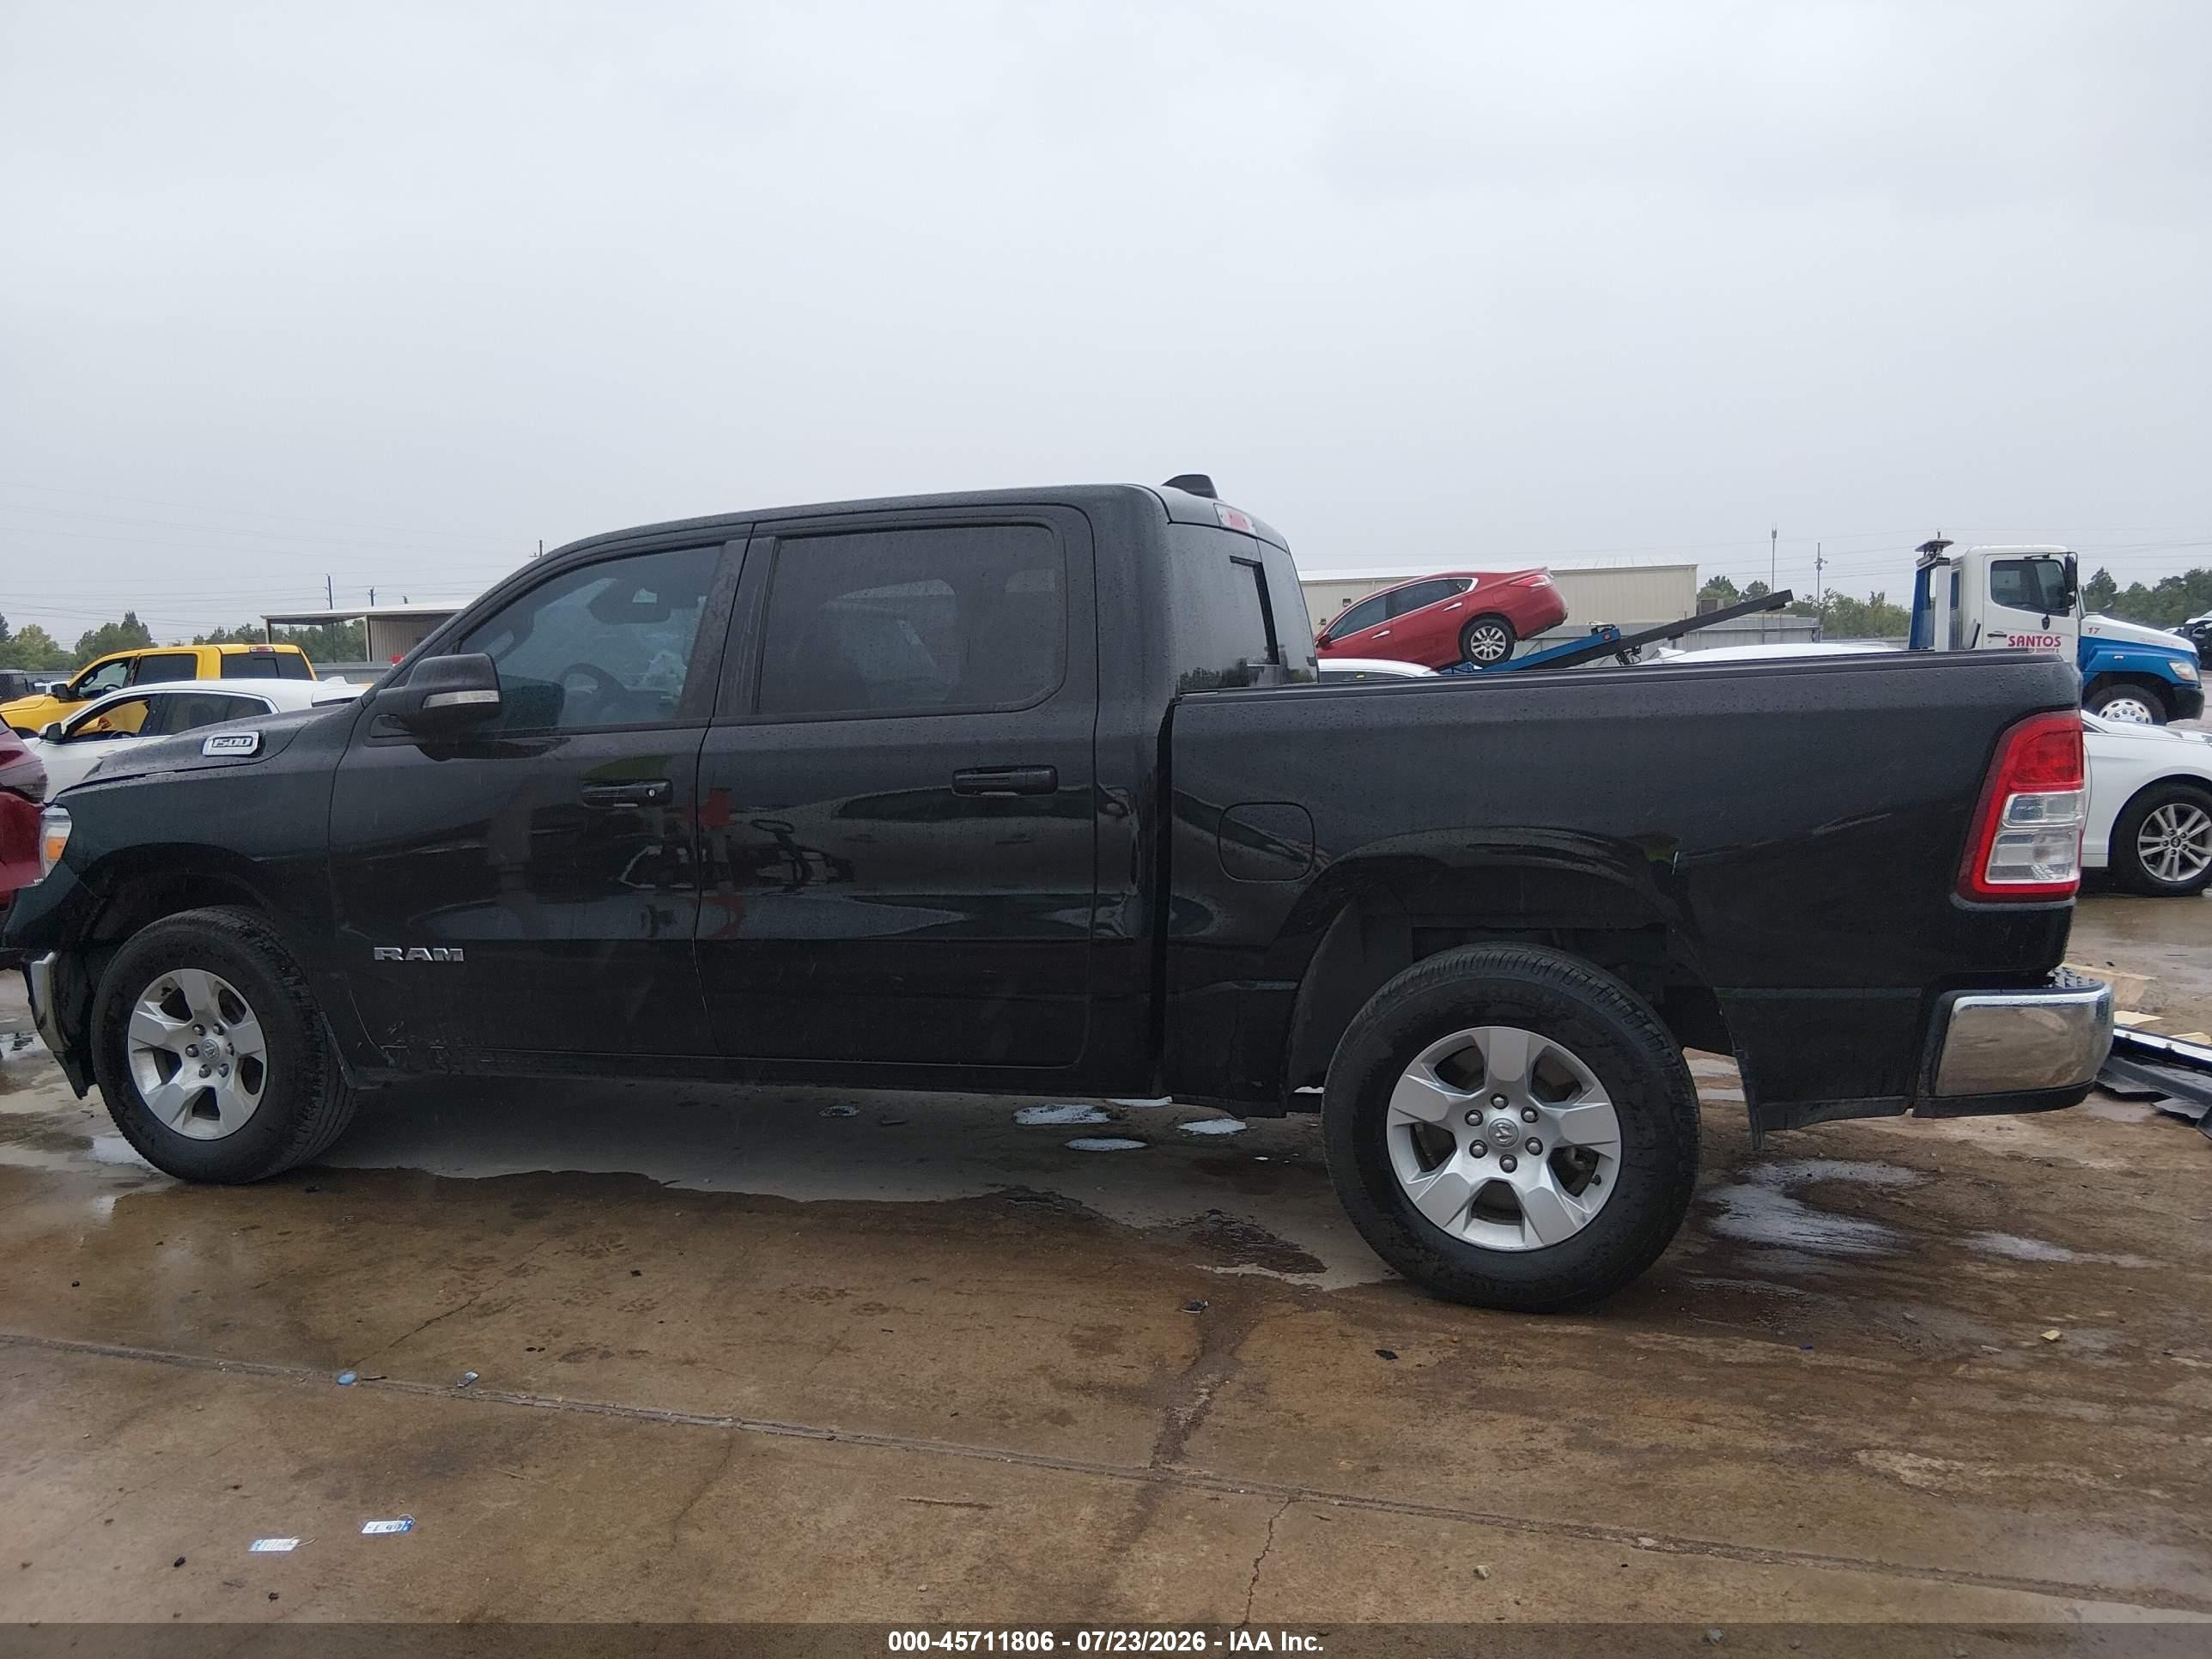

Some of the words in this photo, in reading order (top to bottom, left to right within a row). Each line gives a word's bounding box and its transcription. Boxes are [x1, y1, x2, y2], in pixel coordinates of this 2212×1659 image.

[2008, 635, 2062, 647] SANTOS
[212, 738, 252, 748] 1500
[374, 947, 465, 962] RAM
